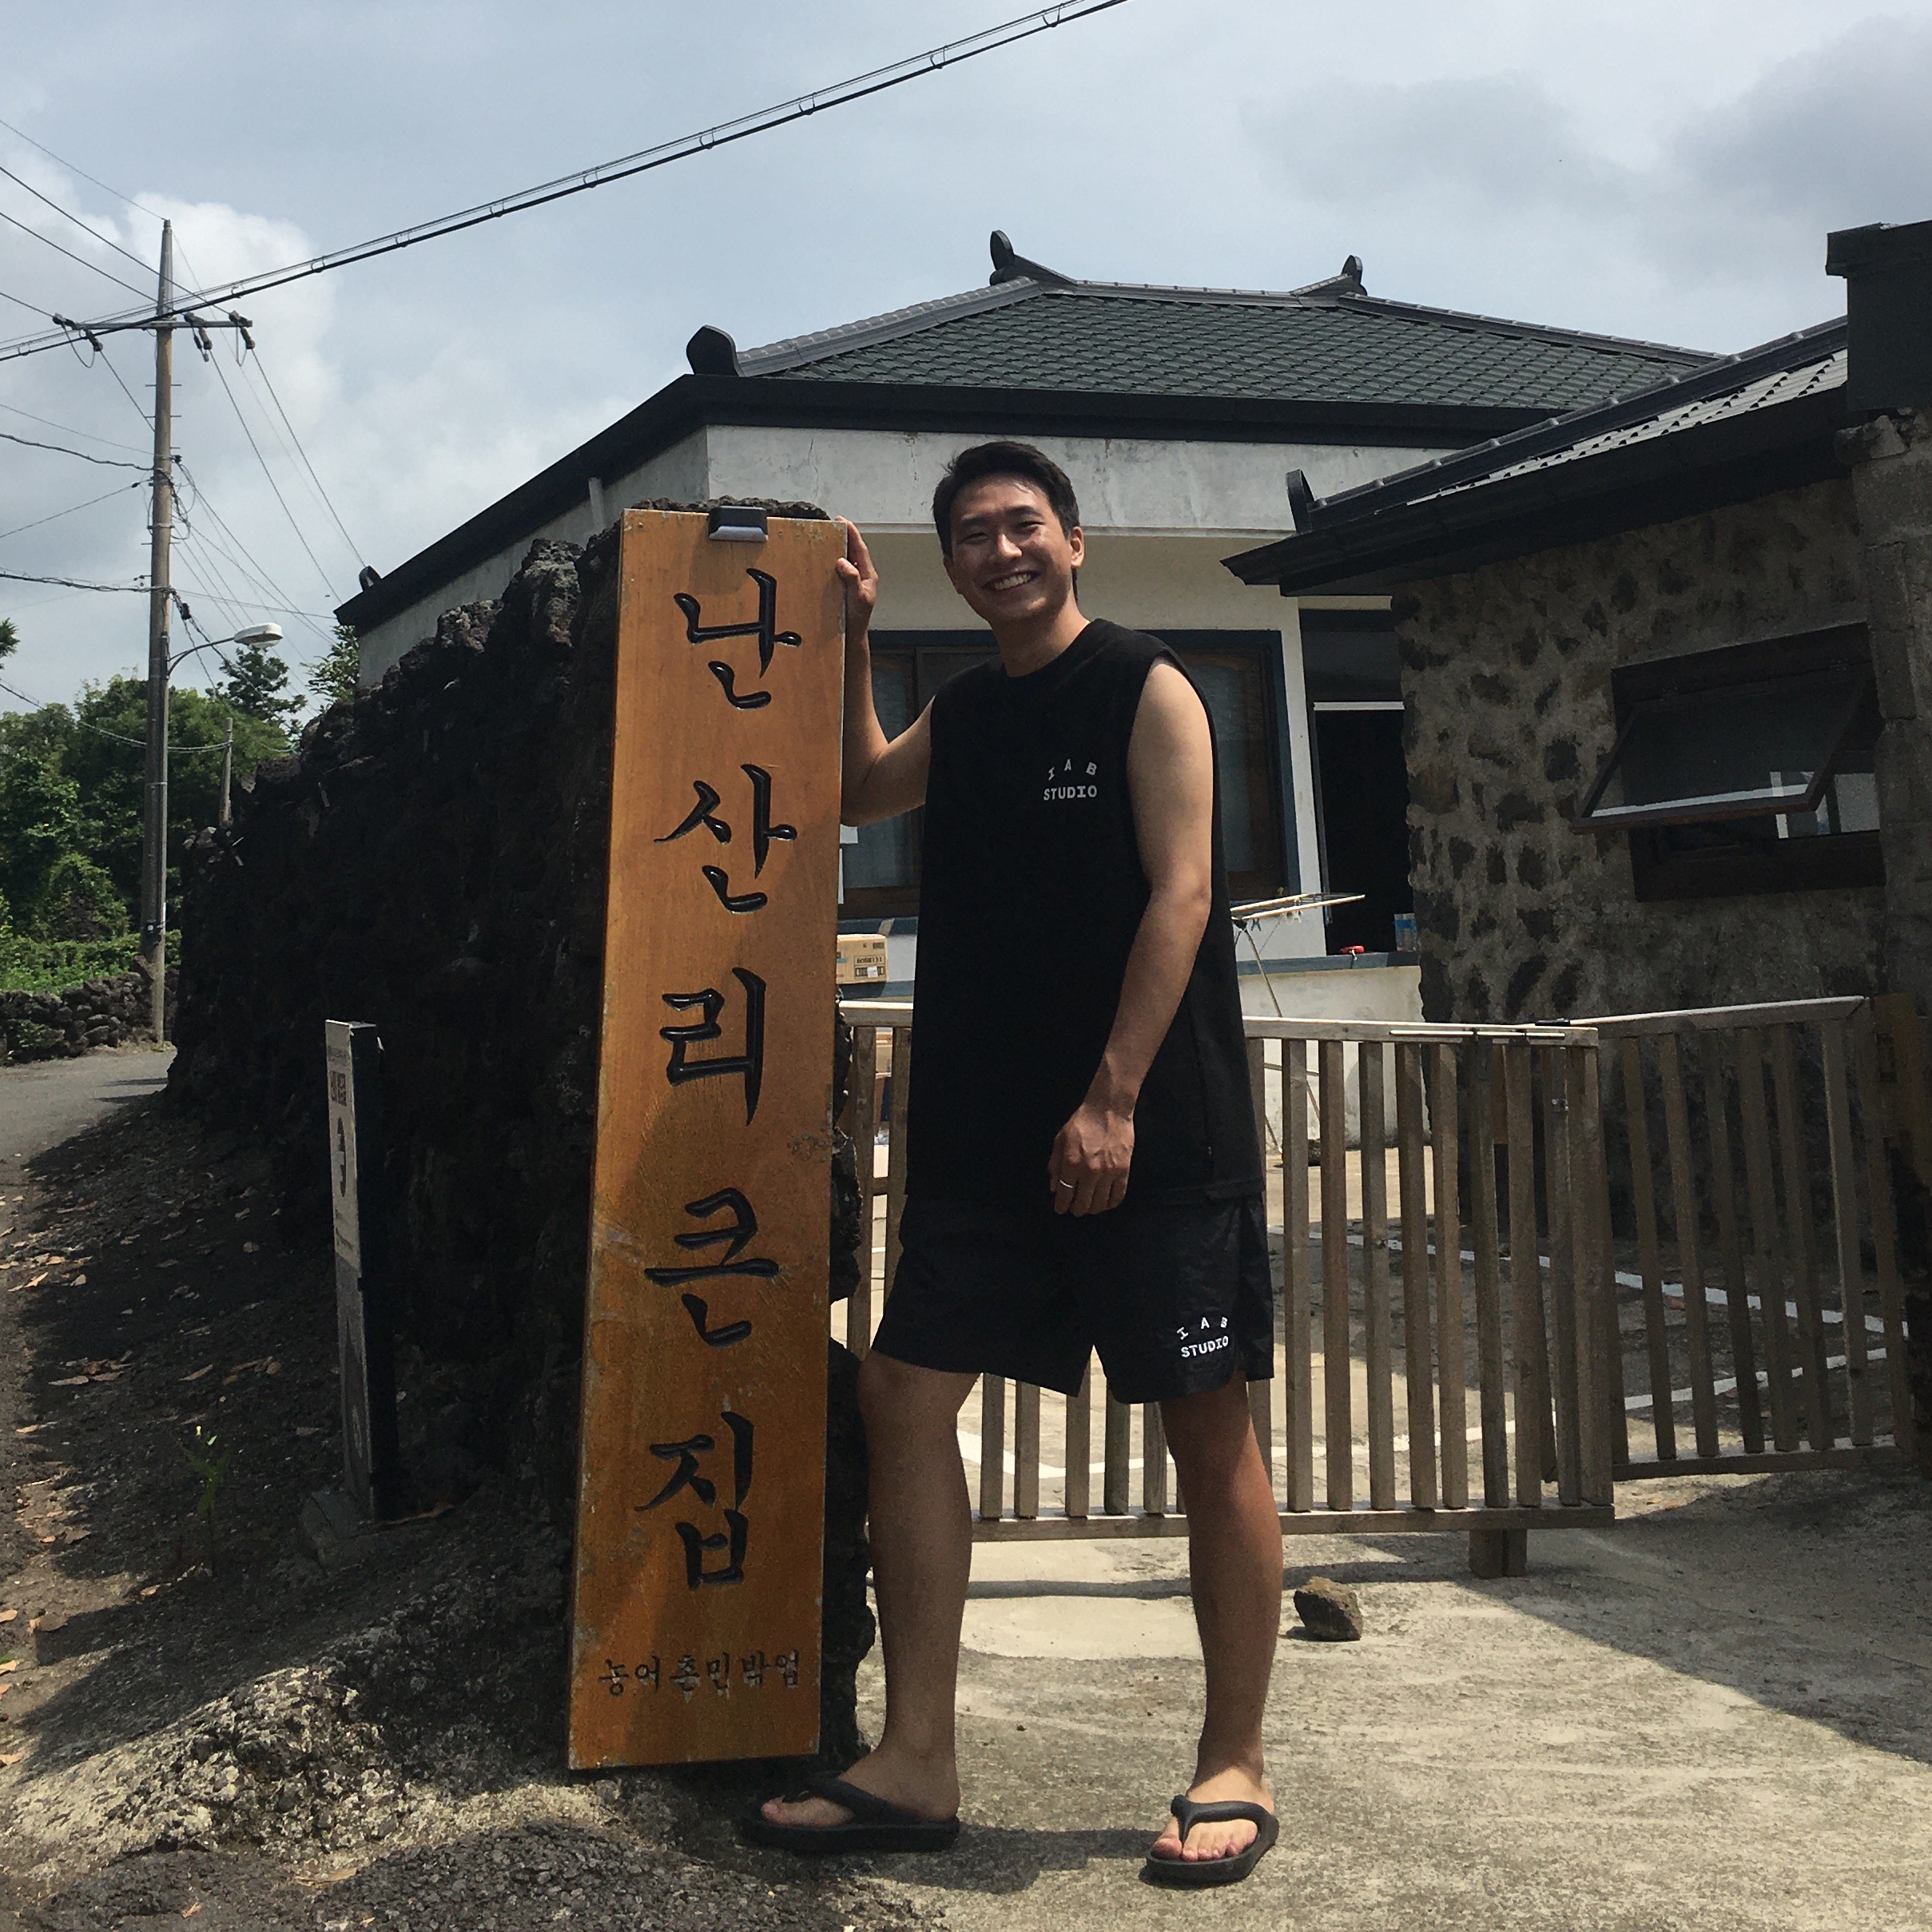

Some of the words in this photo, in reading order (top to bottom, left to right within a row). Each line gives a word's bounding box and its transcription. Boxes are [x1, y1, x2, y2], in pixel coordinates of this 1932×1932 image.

[1043, 785, 1098, 801] STUDIO
[1181, 1335, 1229, 1358] STUDIO
[598, 1649, 798, 1697] 농어촌민박업
